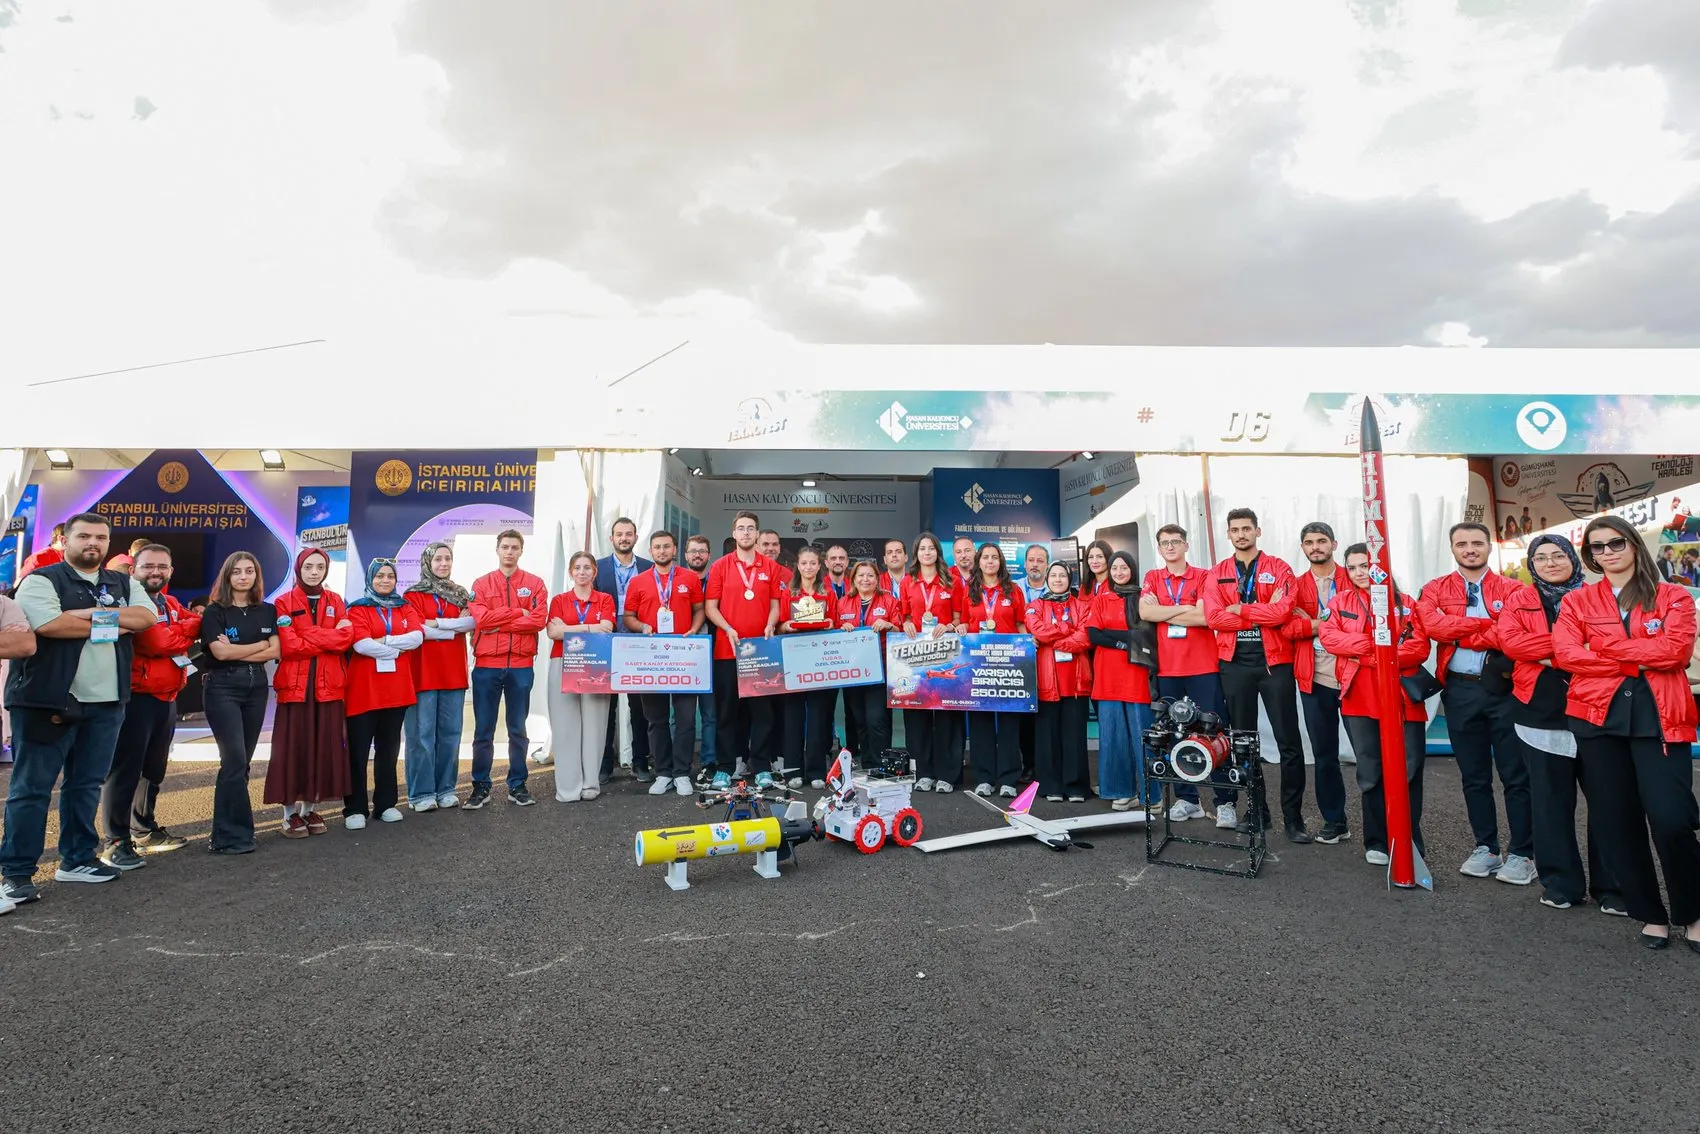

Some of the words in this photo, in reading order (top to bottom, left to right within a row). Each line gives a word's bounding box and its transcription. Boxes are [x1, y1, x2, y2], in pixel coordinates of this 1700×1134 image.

[418, 462, 490, 477] İSTANBUL
[1520, 460, 1556, 471] GÜMÜŞHANE
[1651, 457, 1694, 471] TEKNOLOJİ
[1658, 466, 1693, 478] HAMLESİ
[724, 493, 760, 504] HASAN
[762, 494, 821, 504] KALYONCU
[824, 491, 897, 505] ÜNİVERSİTESİ
[97, 502, 159, 514] İSTANBUL
[161, 502, 248, 515] ÜNİVERSİTESİ
[954, 524, 973, 532] FAKÜLTE
[1001, 525, 1007, 533] VE
[893, 638, 958, 659] TEKNOFEST
[620, 675, 692, 685] 250.000
[796, 668, 861, 684] 100.000
